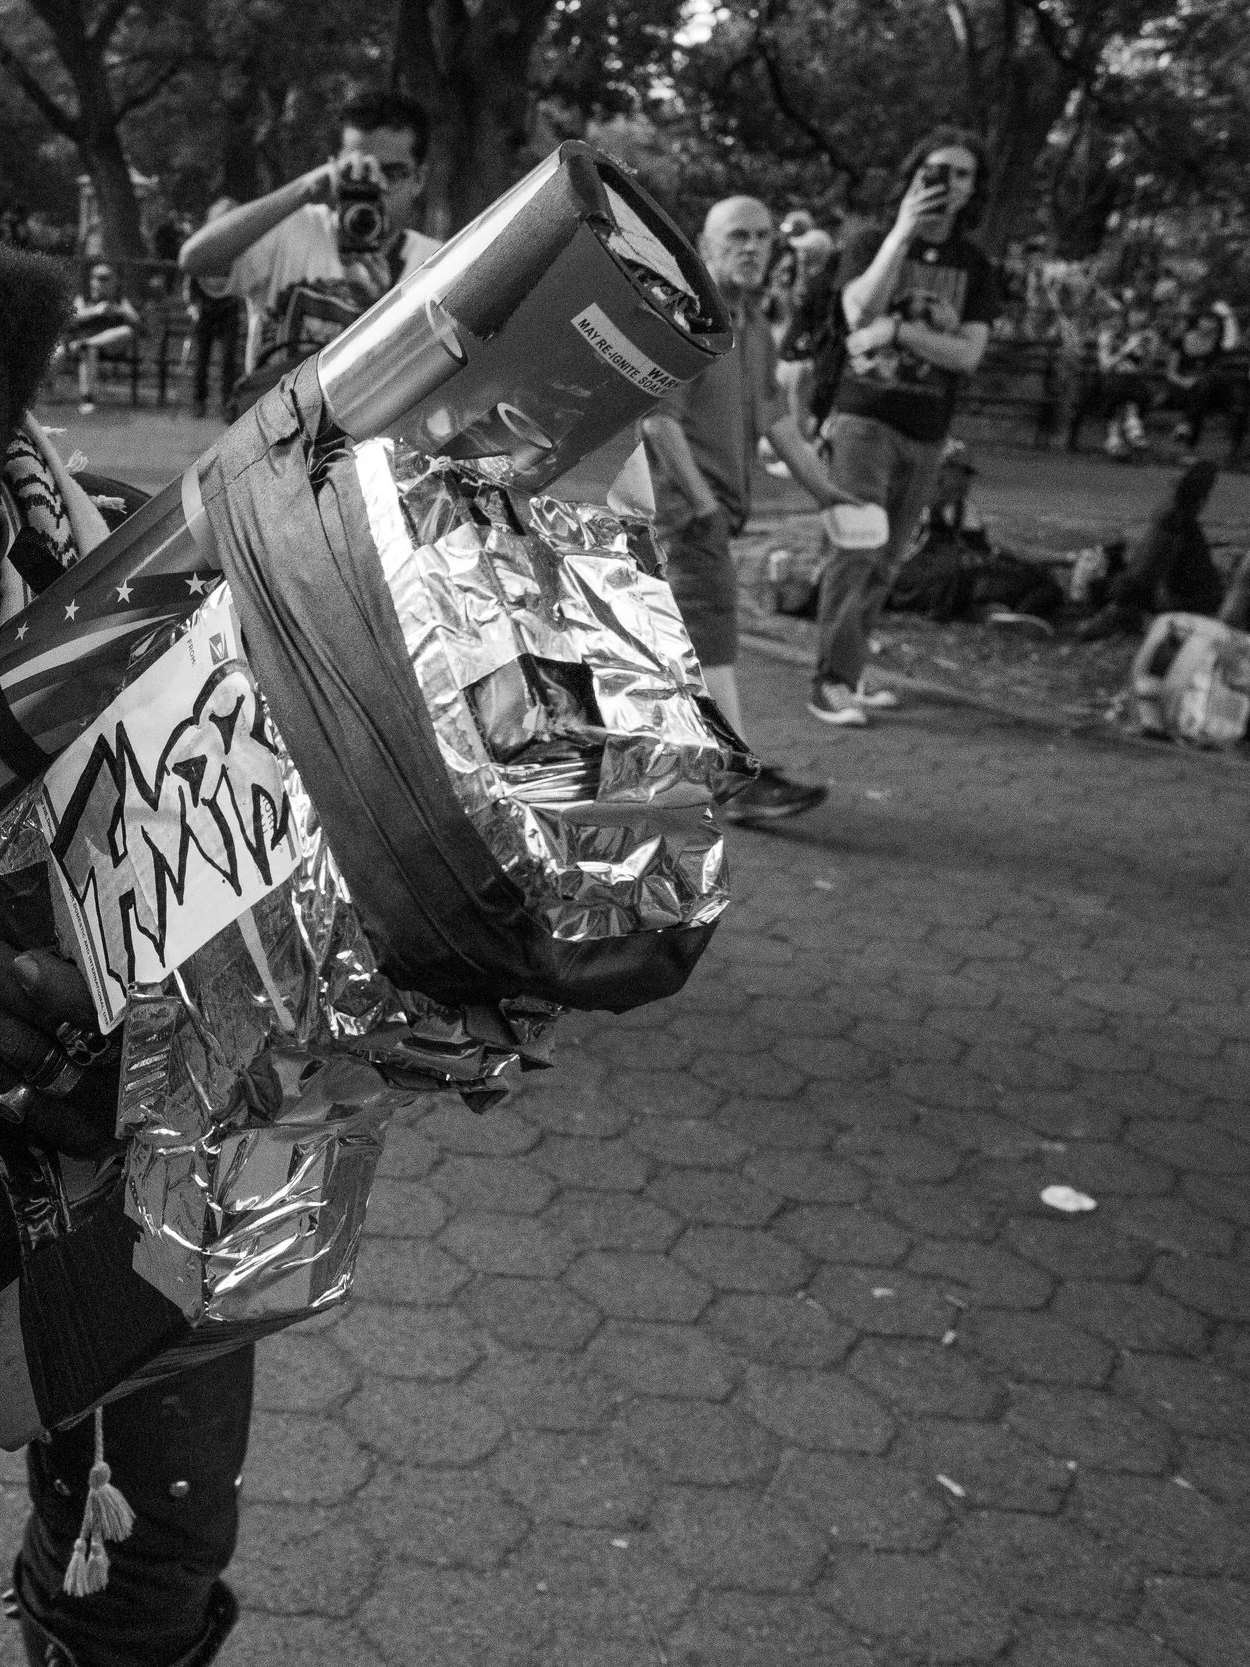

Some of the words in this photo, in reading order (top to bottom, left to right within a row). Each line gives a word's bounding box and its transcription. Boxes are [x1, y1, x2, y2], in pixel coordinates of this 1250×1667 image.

[578, 318, 601, 340] MAY
[638, 376, 660, 393] SOAK
[186, 638, 196, 668] FROM:
[72, 902, 85, 939] DOMESTIC
[87, 955, 104, 1010] INTERNATIONAL
